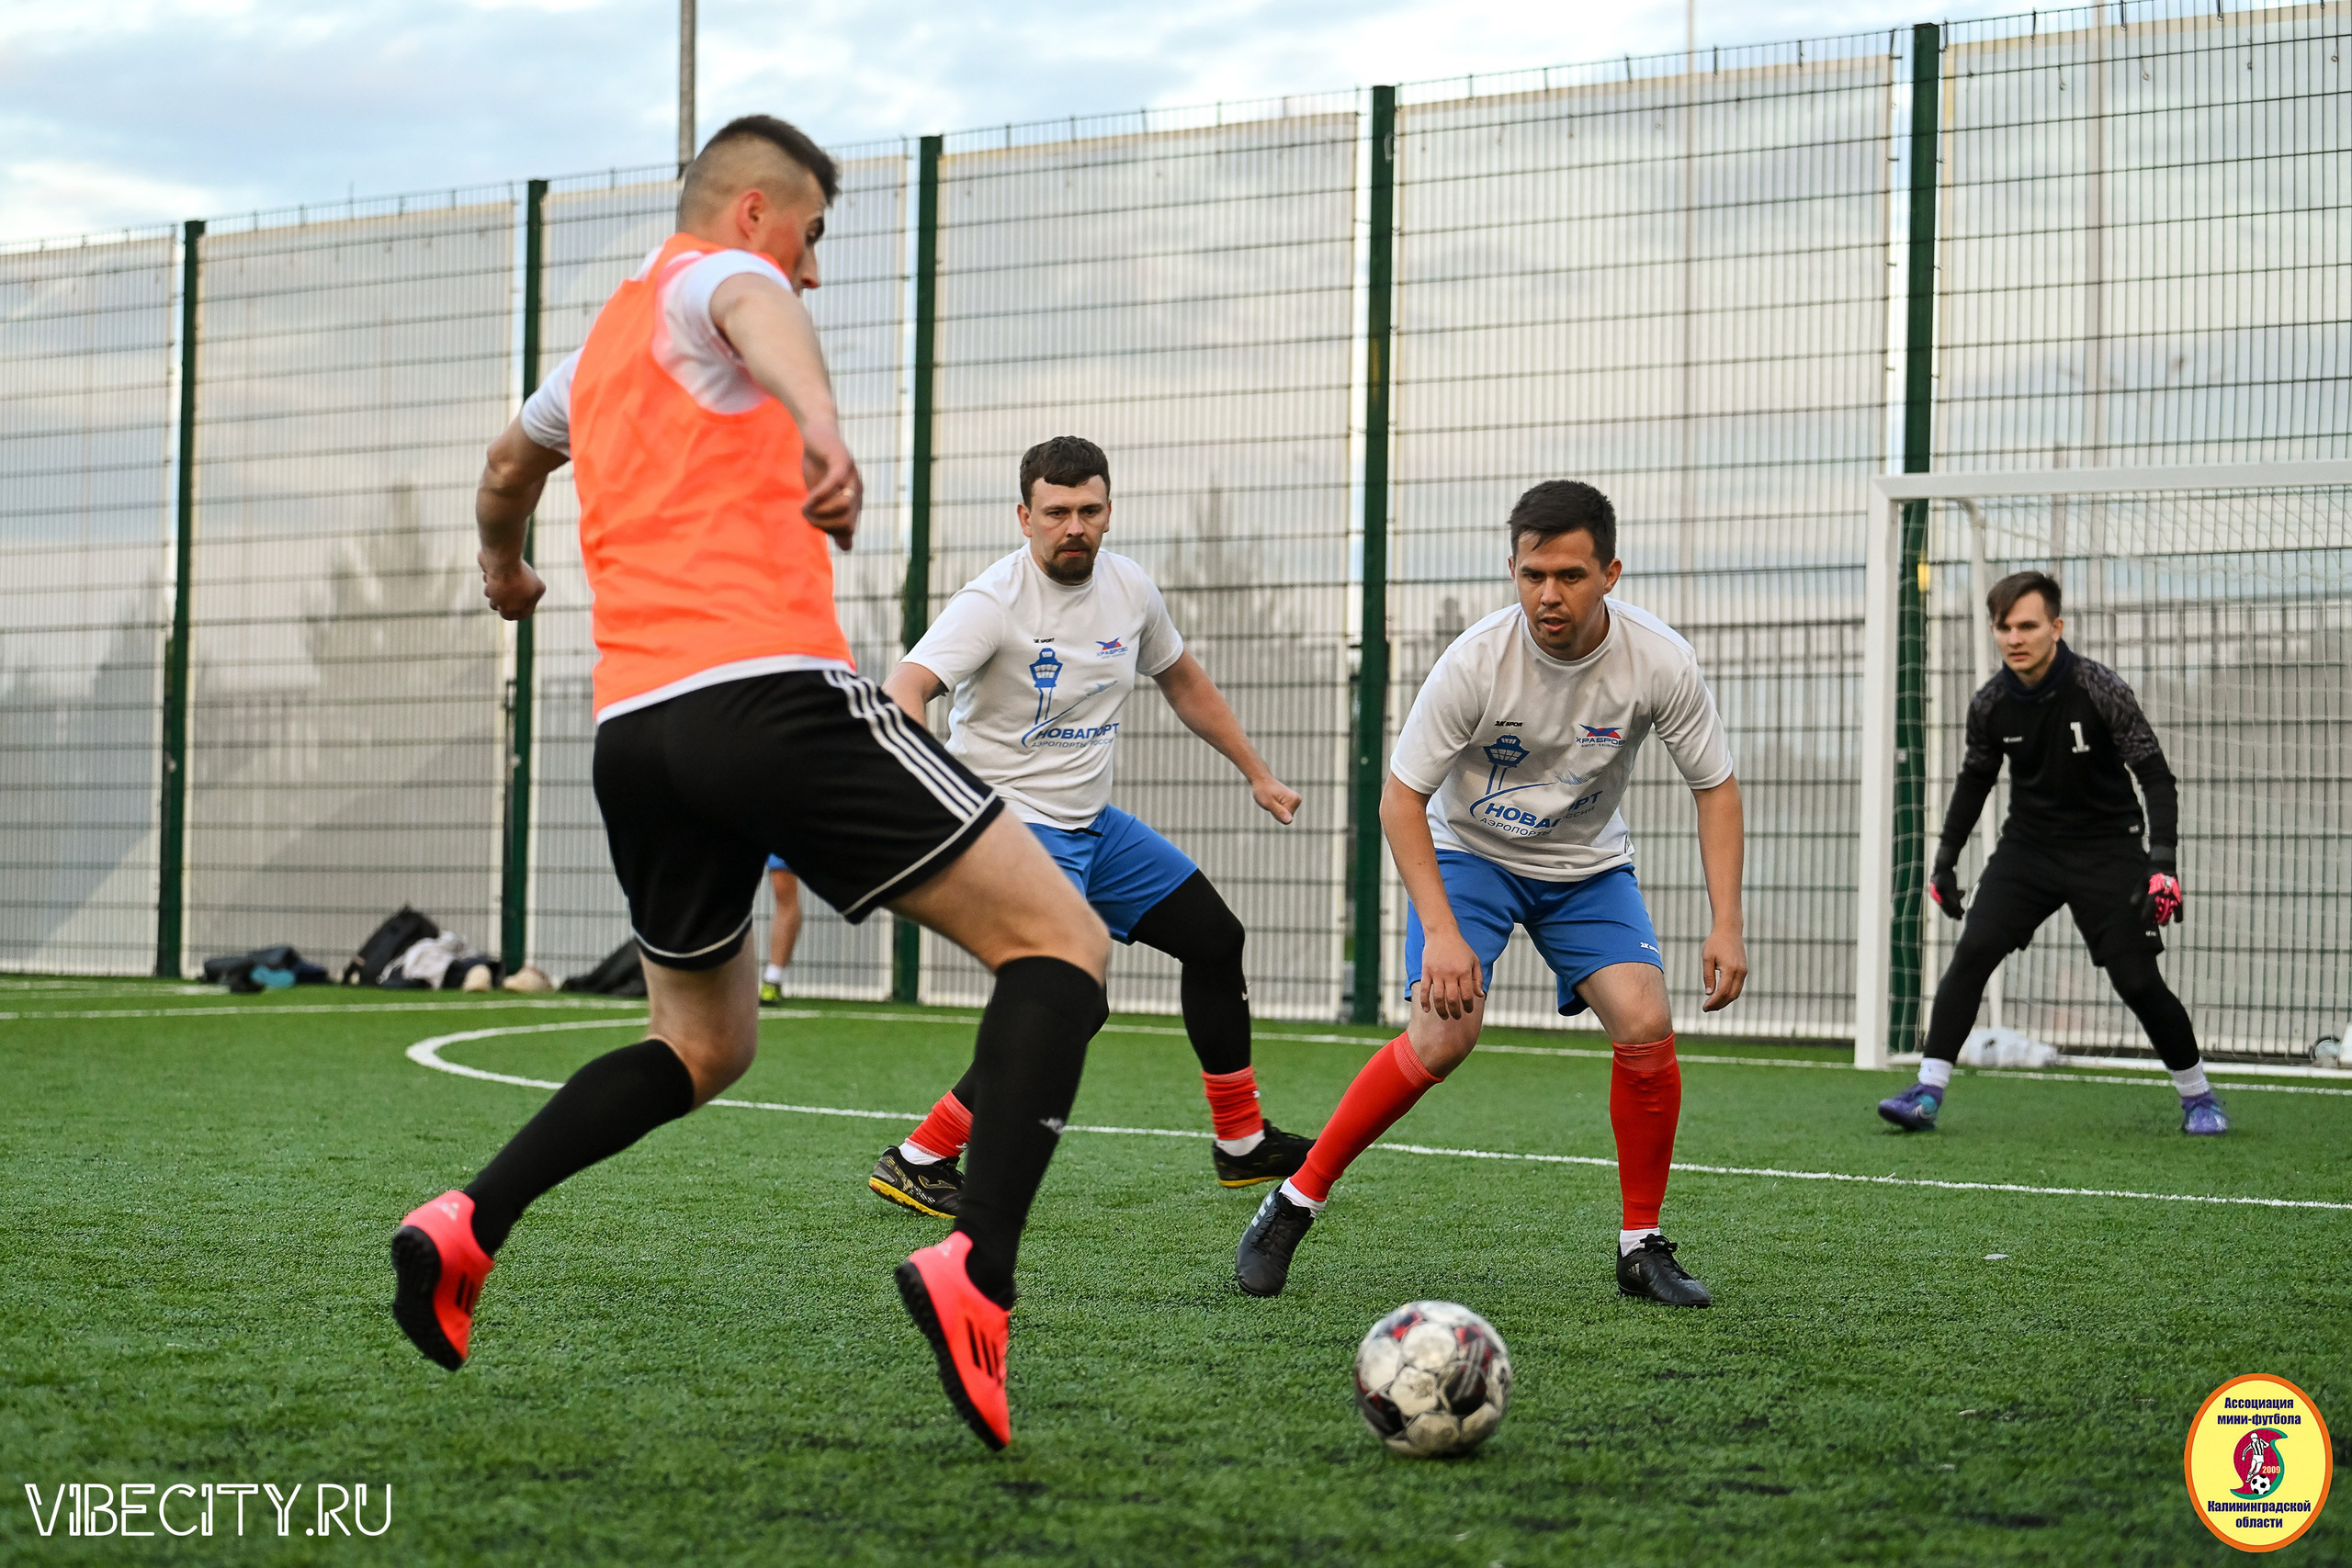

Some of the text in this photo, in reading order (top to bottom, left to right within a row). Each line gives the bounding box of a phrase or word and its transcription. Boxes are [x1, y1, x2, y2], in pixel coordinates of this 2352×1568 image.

[1035, 723, 1119, 739] НОВАПОРТ
[1576, 737, 1626, 746] ХРАБРОВ
[2070, 721, 2090, 753] 1
[1485, 790, 1603, 829] НОВАРТ
